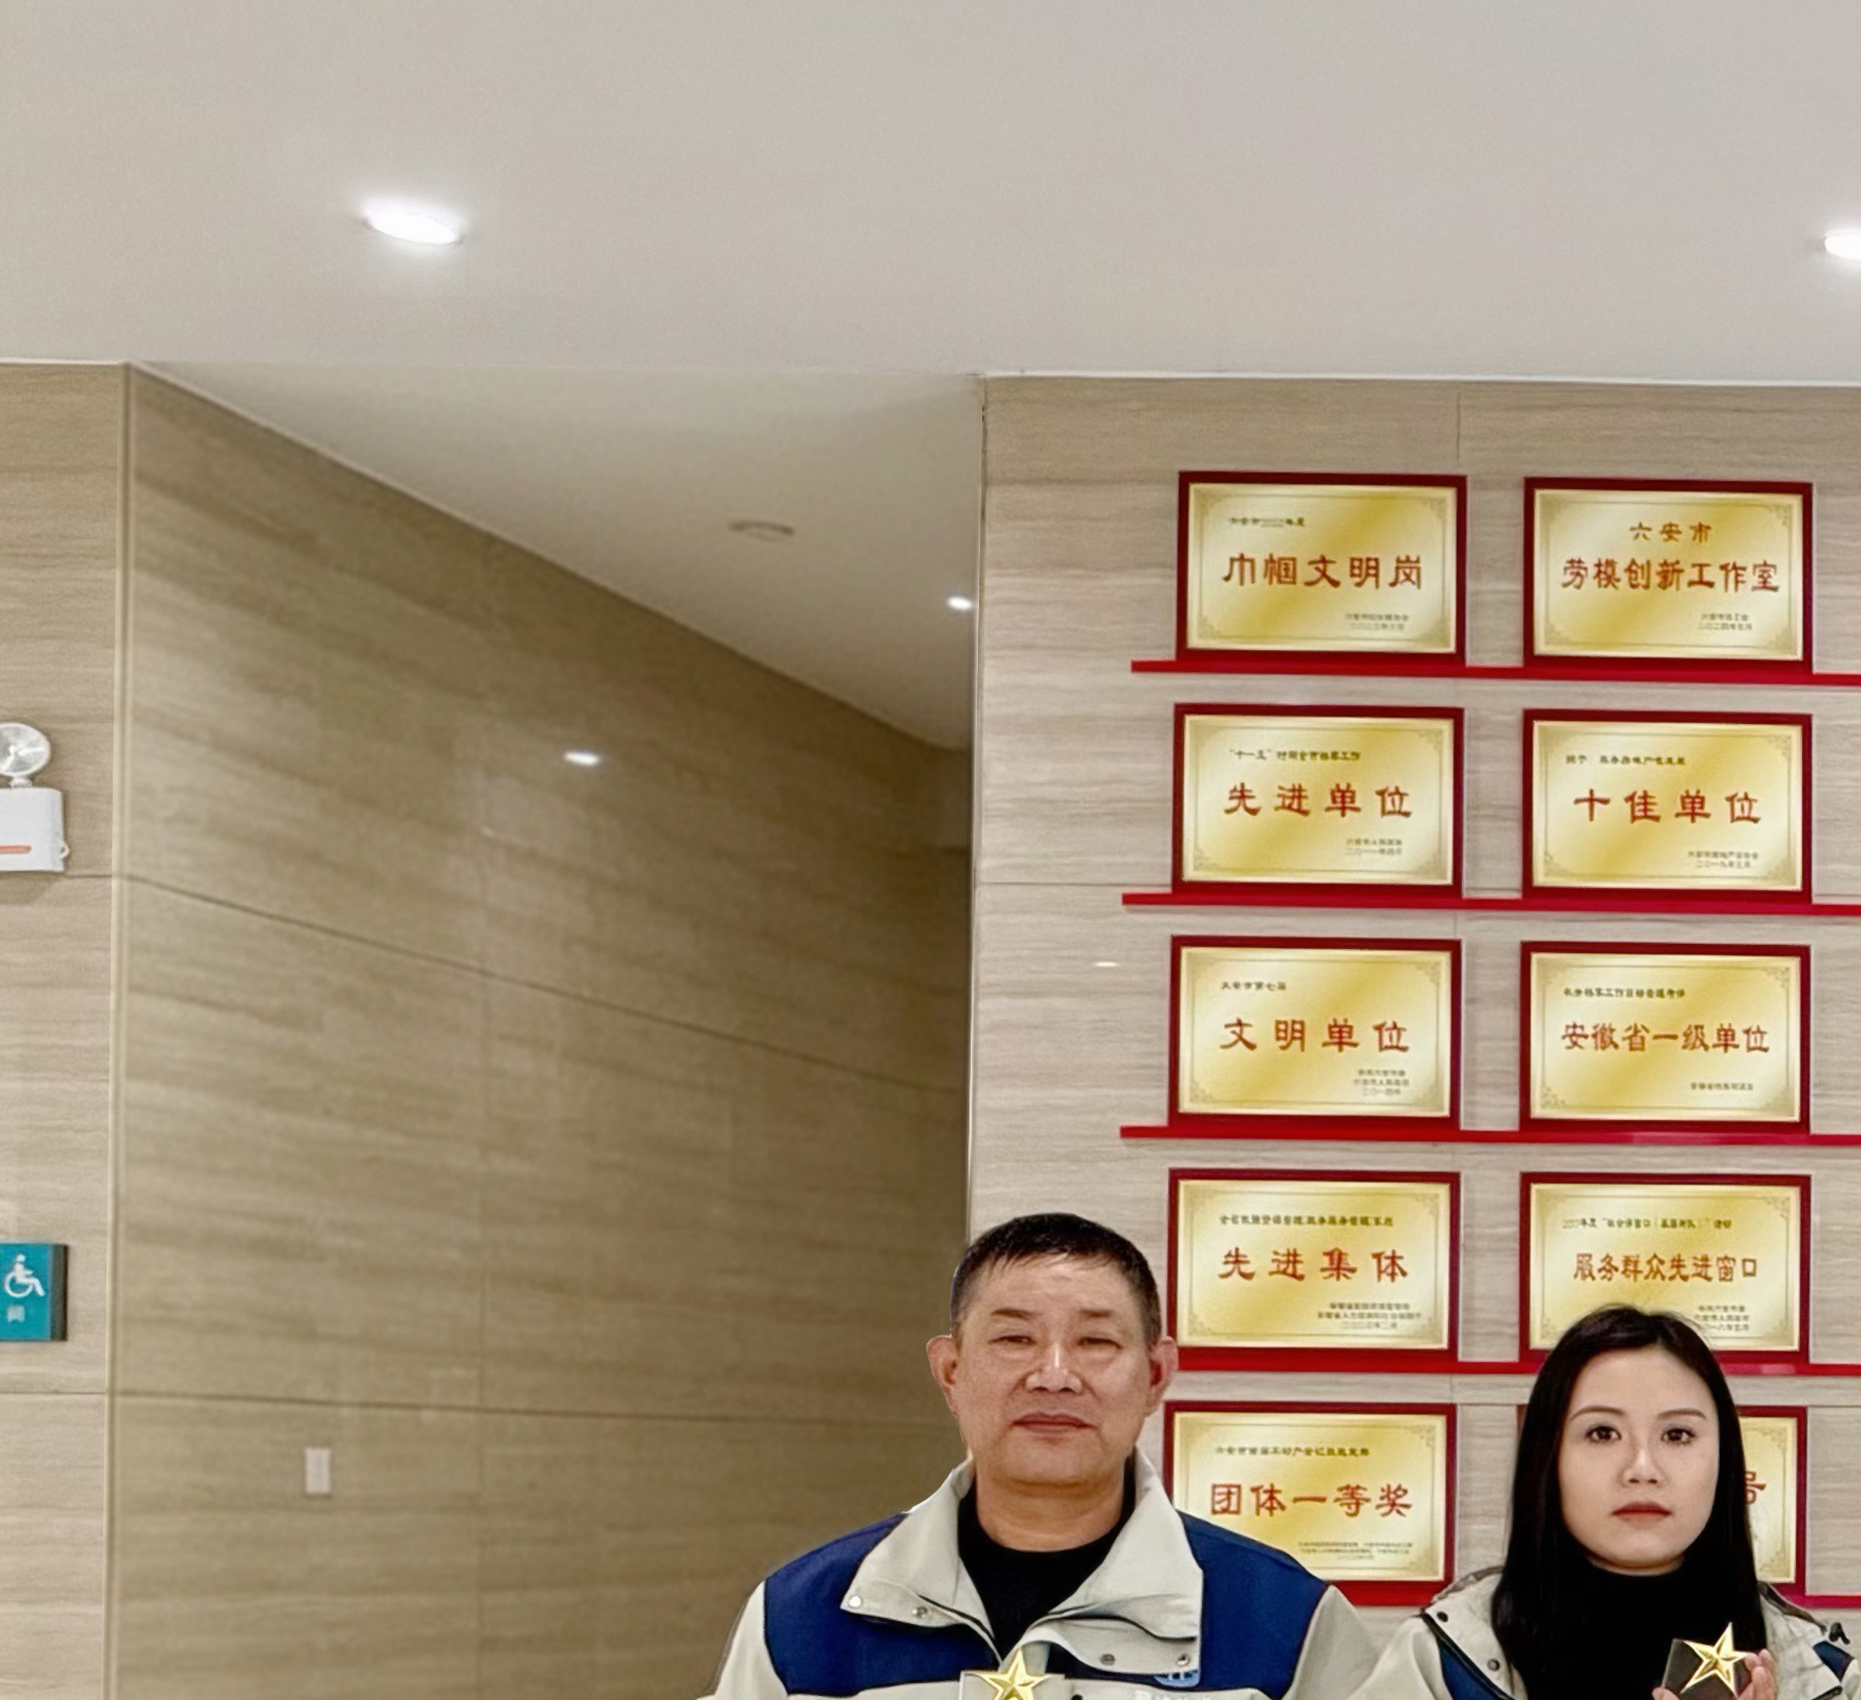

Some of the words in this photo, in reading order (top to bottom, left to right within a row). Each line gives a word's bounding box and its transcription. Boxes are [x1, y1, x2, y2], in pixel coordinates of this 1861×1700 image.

[1630, 521, 1712, 543] 六安市
[1222, 553, 1422, 589] 巾帼文明岗
[1561, 558, 1780, 593] 劳模创新工作室
[1224, 782, 1412, 818] 先进单位
[1573, 788, 1761, 824] 十佳单位
[1219, 1017, 1410, 1052] 文明单位
[1561, 1022, 1770, 1053] 安徽省一级单位
[1219, 1247, 1408, 1283] 先进集体
[1574, 1253, 1757, 1283] 服务群众先进窗口
[1211, 1483, 1413, 1518] 团体一等奖
